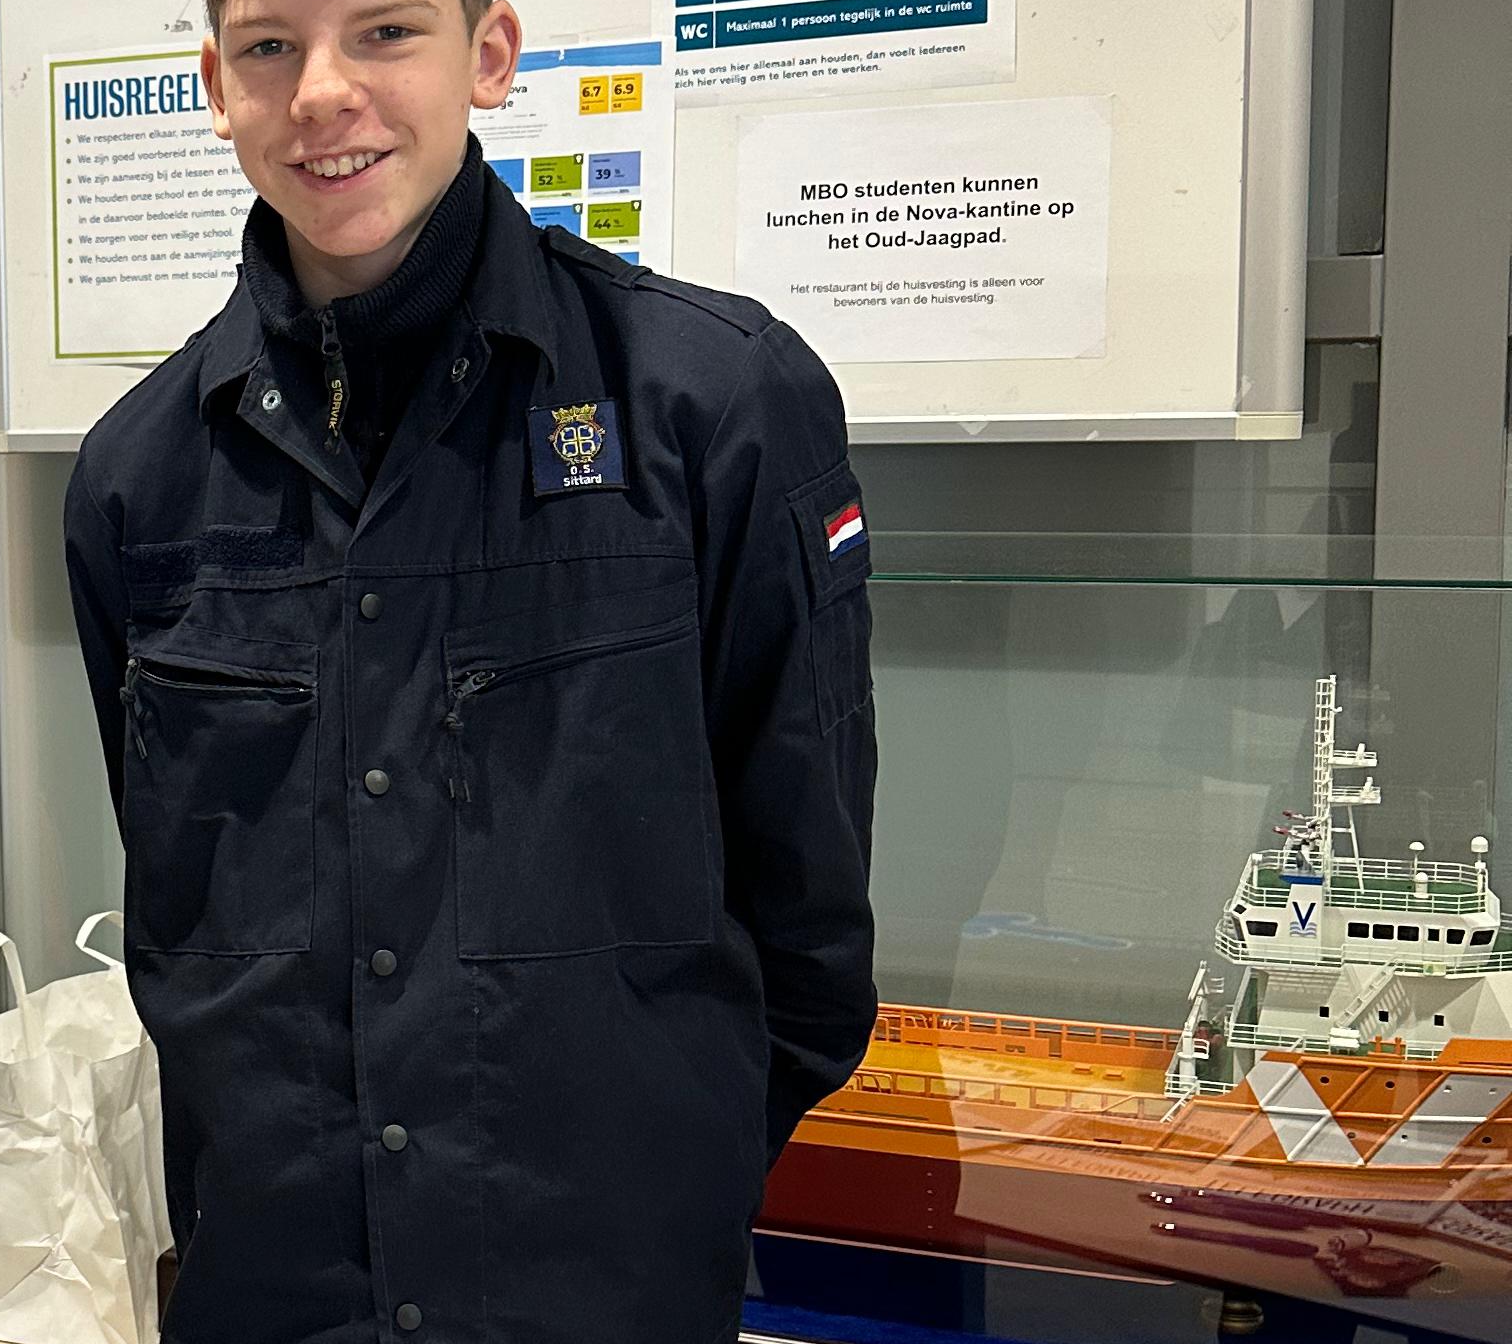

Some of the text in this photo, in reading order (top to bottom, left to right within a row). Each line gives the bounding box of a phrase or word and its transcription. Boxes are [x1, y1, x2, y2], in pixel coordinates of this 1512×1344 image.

[726, 0, 972, 32] Maximaal 1 persoon tegelijk in de wc ruimte
[681, 23, 708, 40] WC
[65, 73, 207, 121] HUISREGEL
[582, 83, 634, 98] 6.7 6.9
[538, 169, 611, 186] 52 39
[801, 175, 1038, 201] MBO studenten kunnen
[593, 218, 612, 230] 44
[767, 201, 1074, 227] lunchen in de Nova-kantine op
[829, 227, 1007, 250] het Oud-Jaagpad.
[563, 473, 602, 487] Sittard
